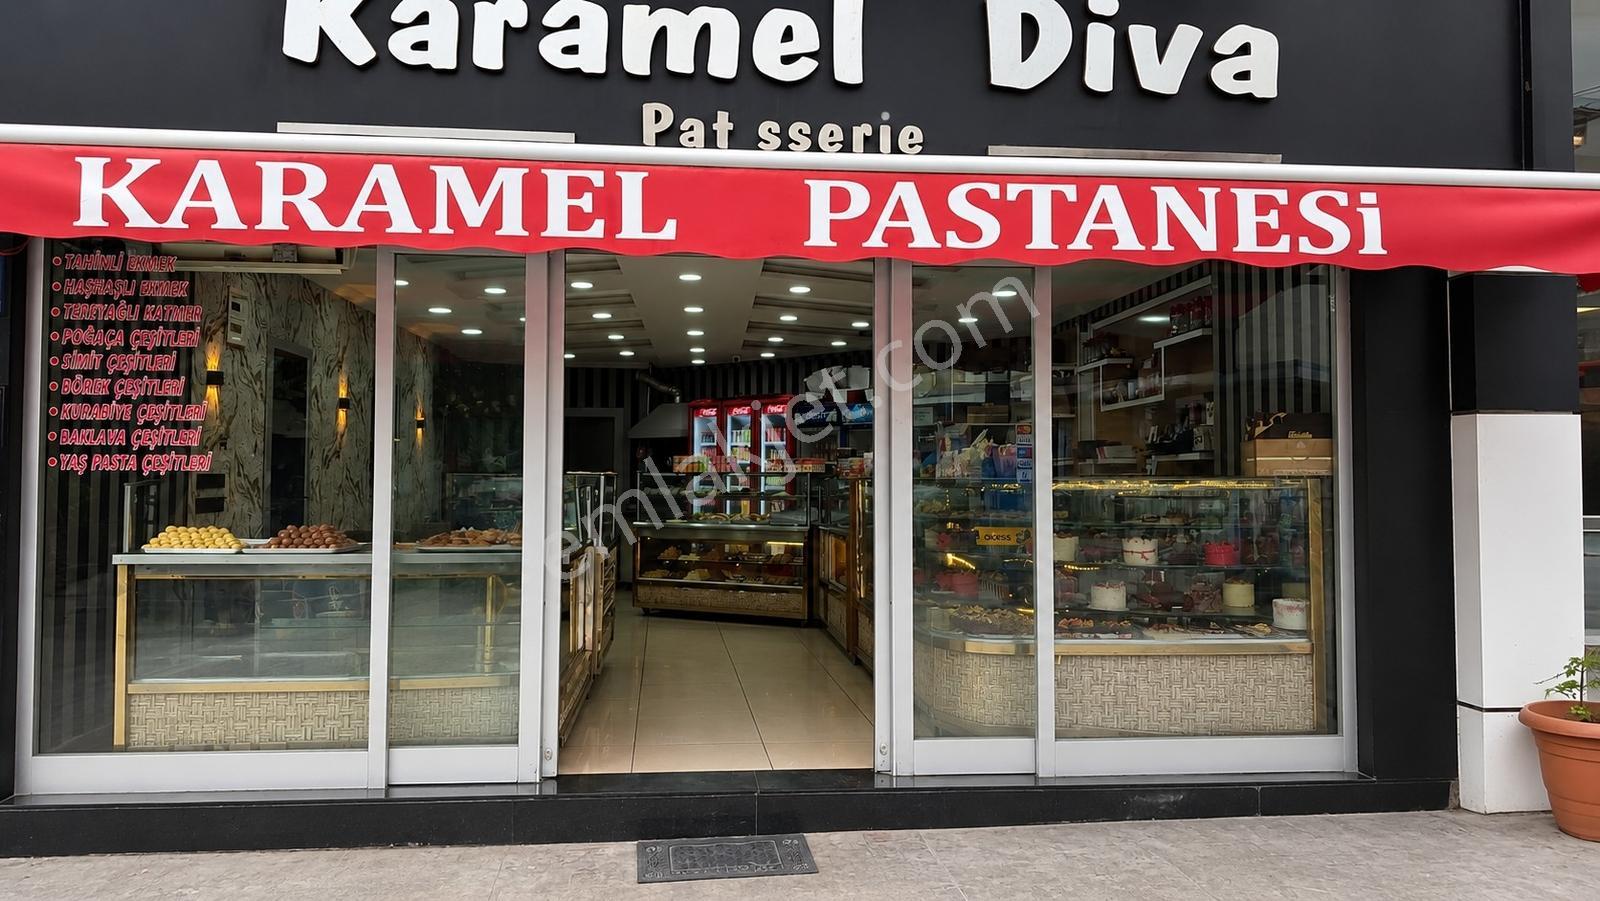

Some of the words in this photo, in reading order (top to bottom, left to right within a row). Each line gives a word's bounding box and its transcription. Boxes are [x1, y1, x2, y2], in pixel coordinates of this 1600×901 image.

[281, 0, 865, 86] Karamel
[986, 0, 1281, 100] Diva
[642, 102, 734, 149] Pat
[756, 111, 925, 154] sserie
[73, 155, 679, 242] KARAMEL
[64, 251, 125, 272] TAHİNLİ
[126, 255, 177, 272] EKMEK
[64, 279, 136, 299] HAŞHAŞLI
[139, 280, 189, 297] EKMEK
[63, 301, 139, 321] TEREYAĞLI
[143, 305, 202, 322] KATMER
[61, 325, 124, 349] POĞAÇA
[130, 326, 200, 350] ÇEŞİTLERİ
[61, 349, 103, 370] SİMİT
[107, 350, 177, 375] ÇEŞİTLERİ
[61, 375, 111, 395] BÖREK
[114, 376, 185, 399] ÇEŞİTLERİ
[60, 401, 132, 420] KURABİYE
[136, 400, 208, 425] ÇEŞİTLERİ
[60, 428, 126, 445] BAKLAVA
[131, 426, 203, 450] ÇEŞİTLERİ
[60, 454, 88, 475] YAŞ
[91, 454, 137, 470] PASTA
[142, 451, 213, 475] ÇEŞİTLERİ
